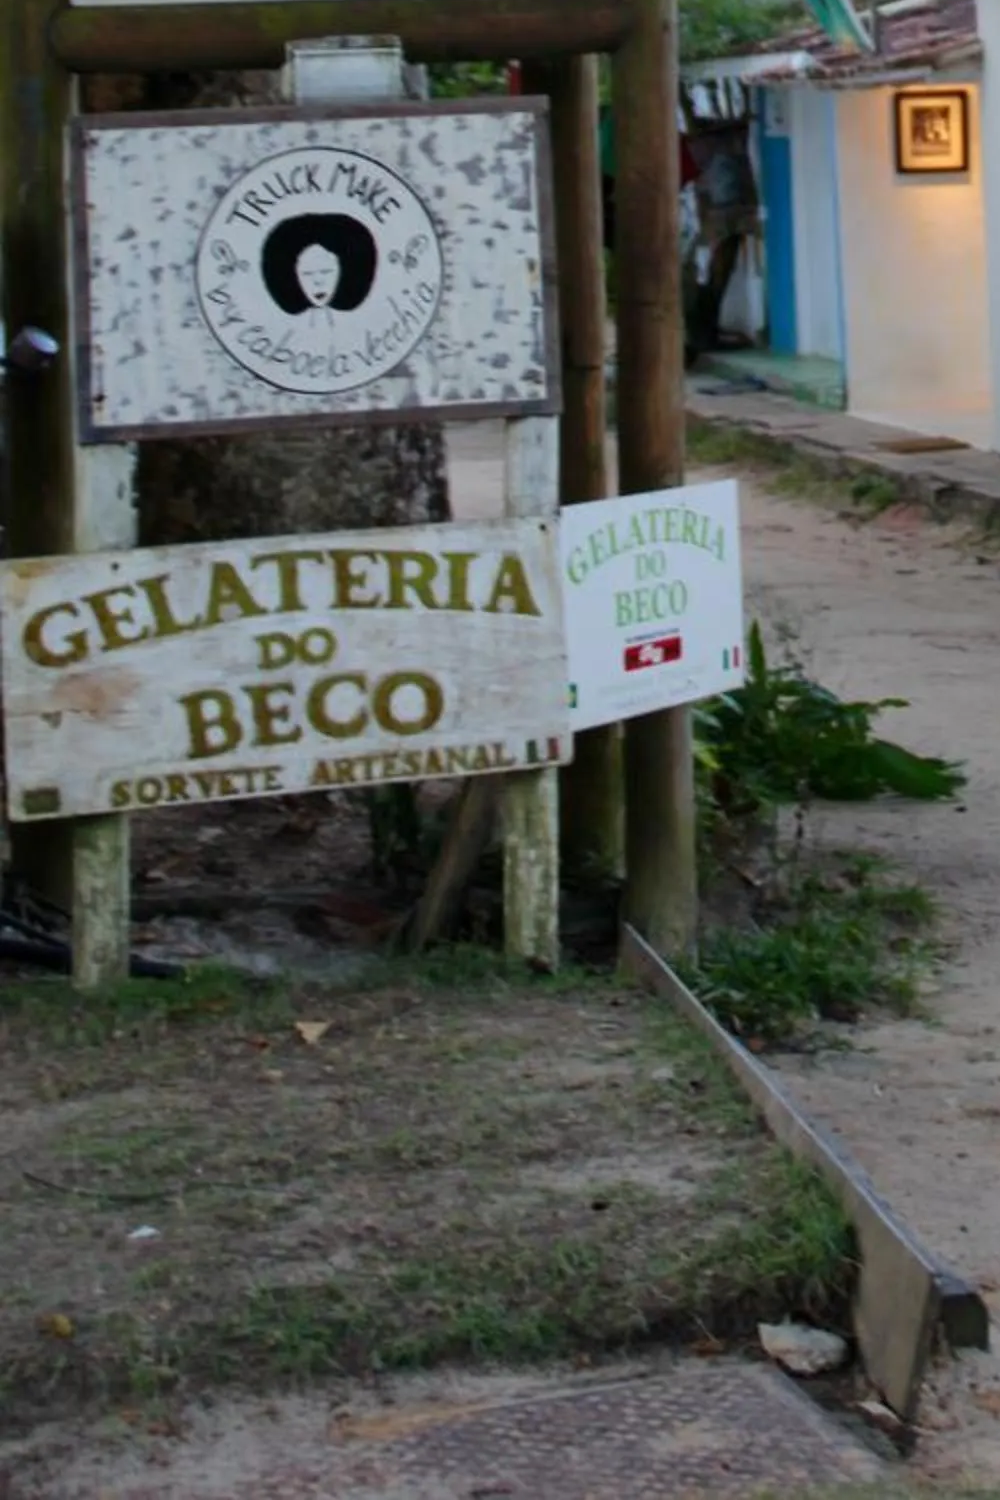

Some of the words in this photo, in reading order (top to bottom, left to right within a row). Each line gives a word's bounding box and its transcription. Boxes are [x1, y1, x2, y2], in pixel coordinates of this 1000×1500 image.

[225, 163, 322, 227] TRUCK
[327, 161, 402, 224] MAKE
[566, 506, 725, 585] GELATERIA
[633, 550, 666, 581] DO
[21, 548, 543, 669] GELATERIA
[614, 579, 688, 627] BECO
[253, 627, 338, 670] DO
[178, 671, 445, 759] BECO
[110, 765, 284, 807] SORVETE
[310, 741, 517, 786] ARTESANAL
